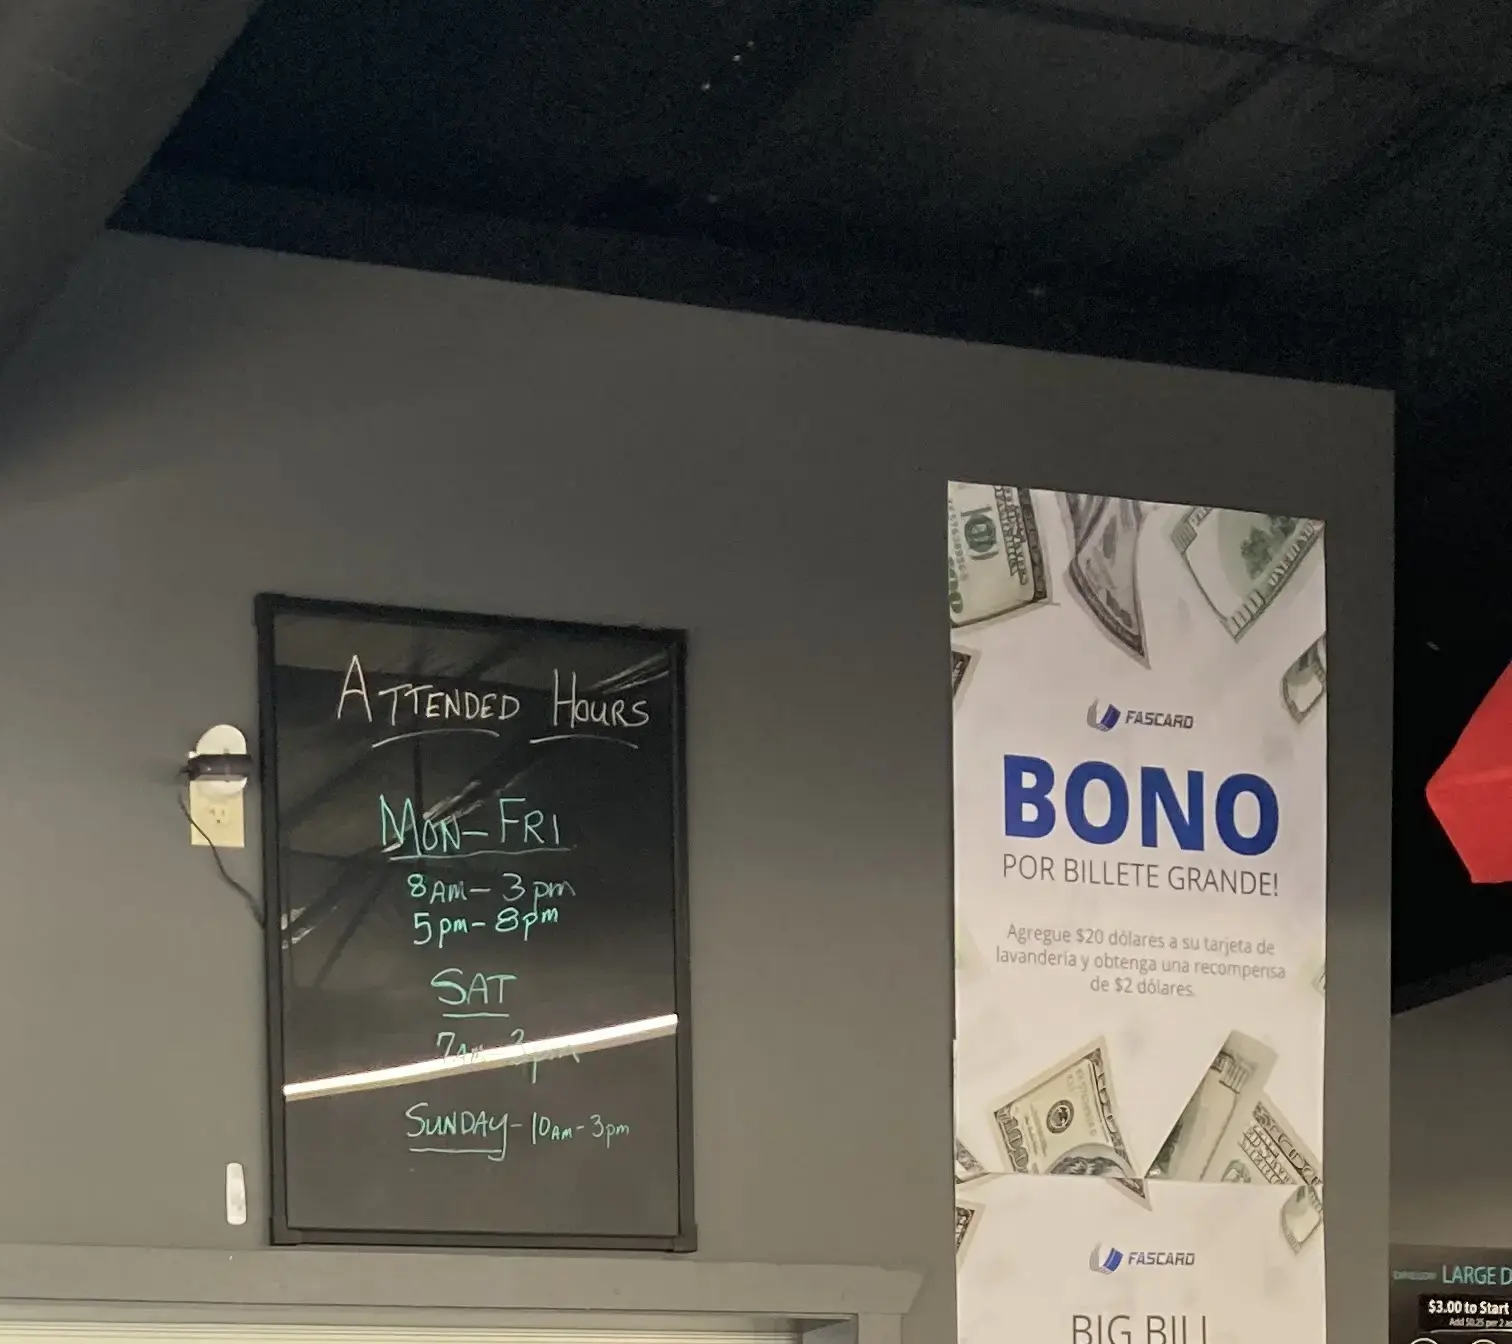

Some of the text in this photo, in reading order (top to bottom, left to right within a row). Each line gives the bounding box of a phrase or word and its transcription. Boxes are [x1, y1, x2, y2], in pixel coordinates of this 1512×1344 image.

[337, 655, 649, 728] ATTENDED HOURS
[1124, 710, 1193, 729] FASCARD
[1004, 754, 1279, 856] BONO
[1003, 854, 1278, 897] POR BILLETE GRANDE!
[1007, 924, 1275, 957] Agregue $20 dólares a su tarjeta de
[996, 945, 1286, 980] lavandería y obtenga una recompensa
[430, 968, 517, 1006] SAT
[1090, 975, 1110, 992] de
[1115, 977, 1133, 993] $2
[1128, 1251, 1195, 1266] FASCARD
[1442, 1265, 1497, 1285] LARGE
[1428, 1299, 1510, 1315] $3.00 to Start
